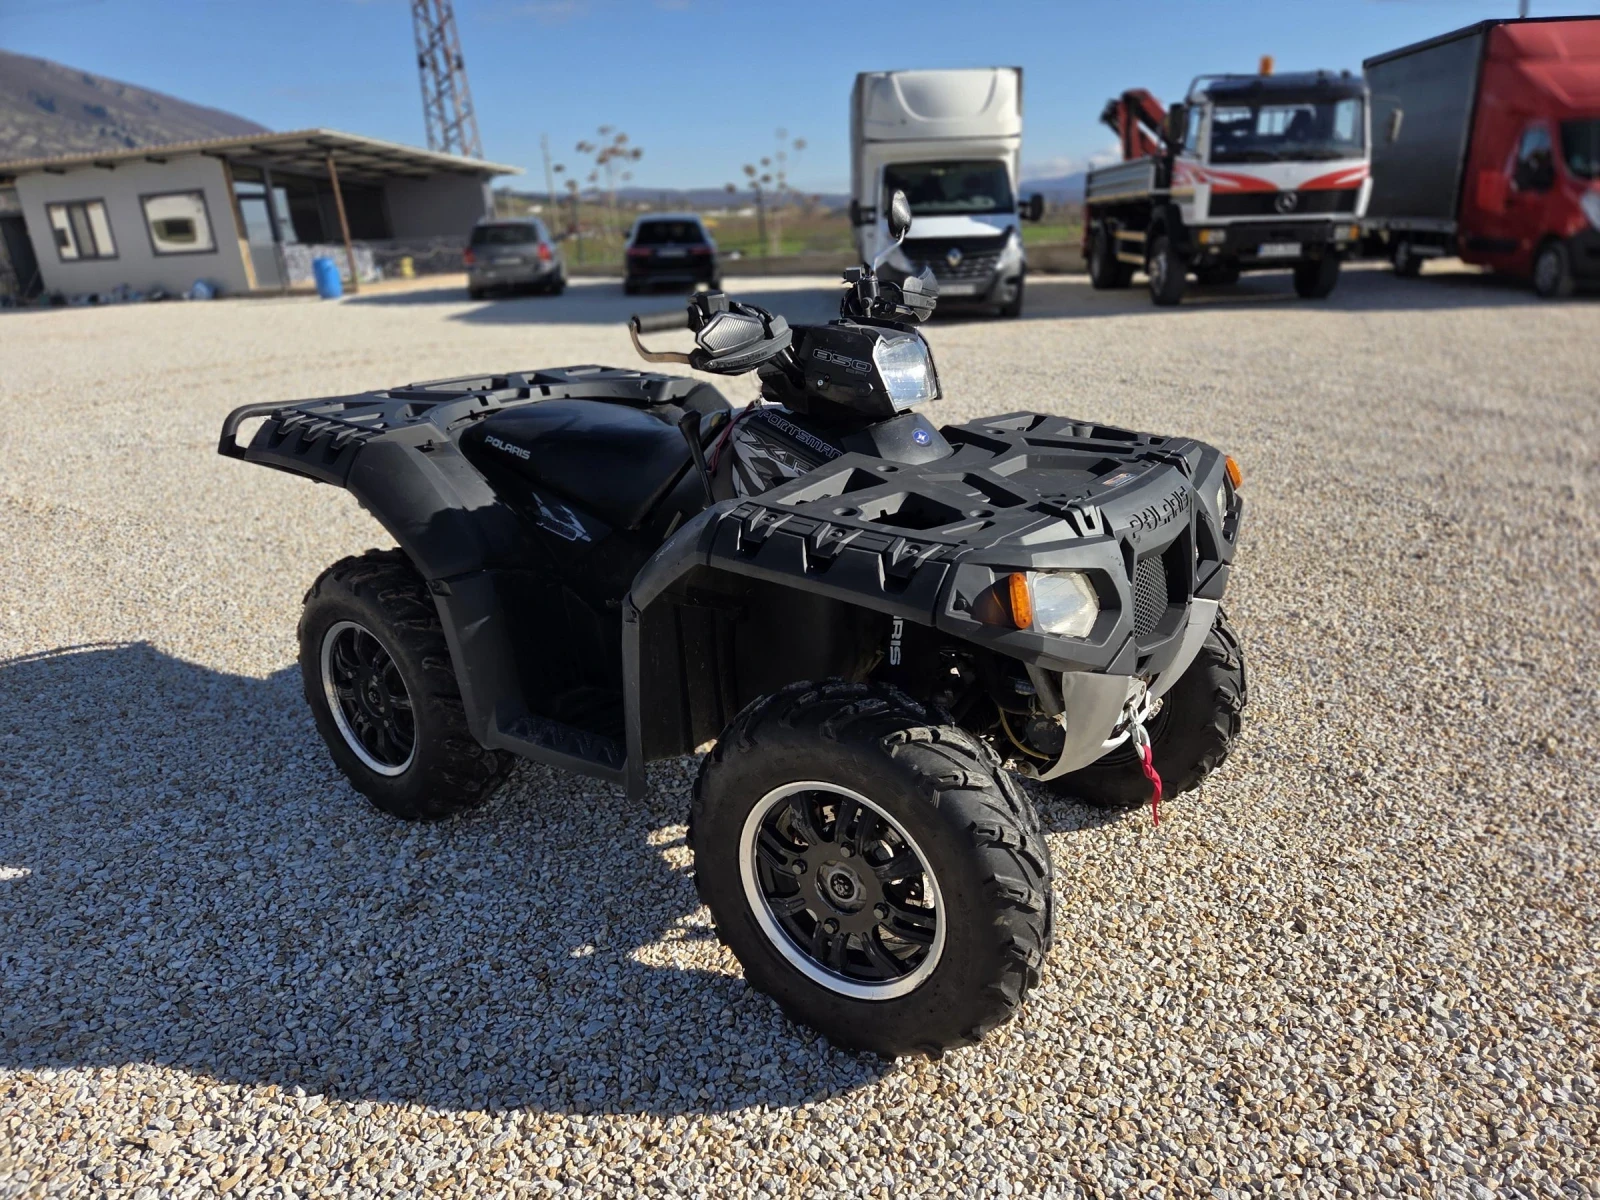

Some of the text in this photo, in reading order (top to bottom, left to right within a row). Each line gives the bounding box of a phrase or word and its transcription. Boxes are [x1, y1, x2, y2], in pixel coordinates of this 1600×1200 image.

[813, 348, 872, 372] 850
[484, 435, 531, 460] POLARIS
[1126, 485, 1189, 539] POLARIS
